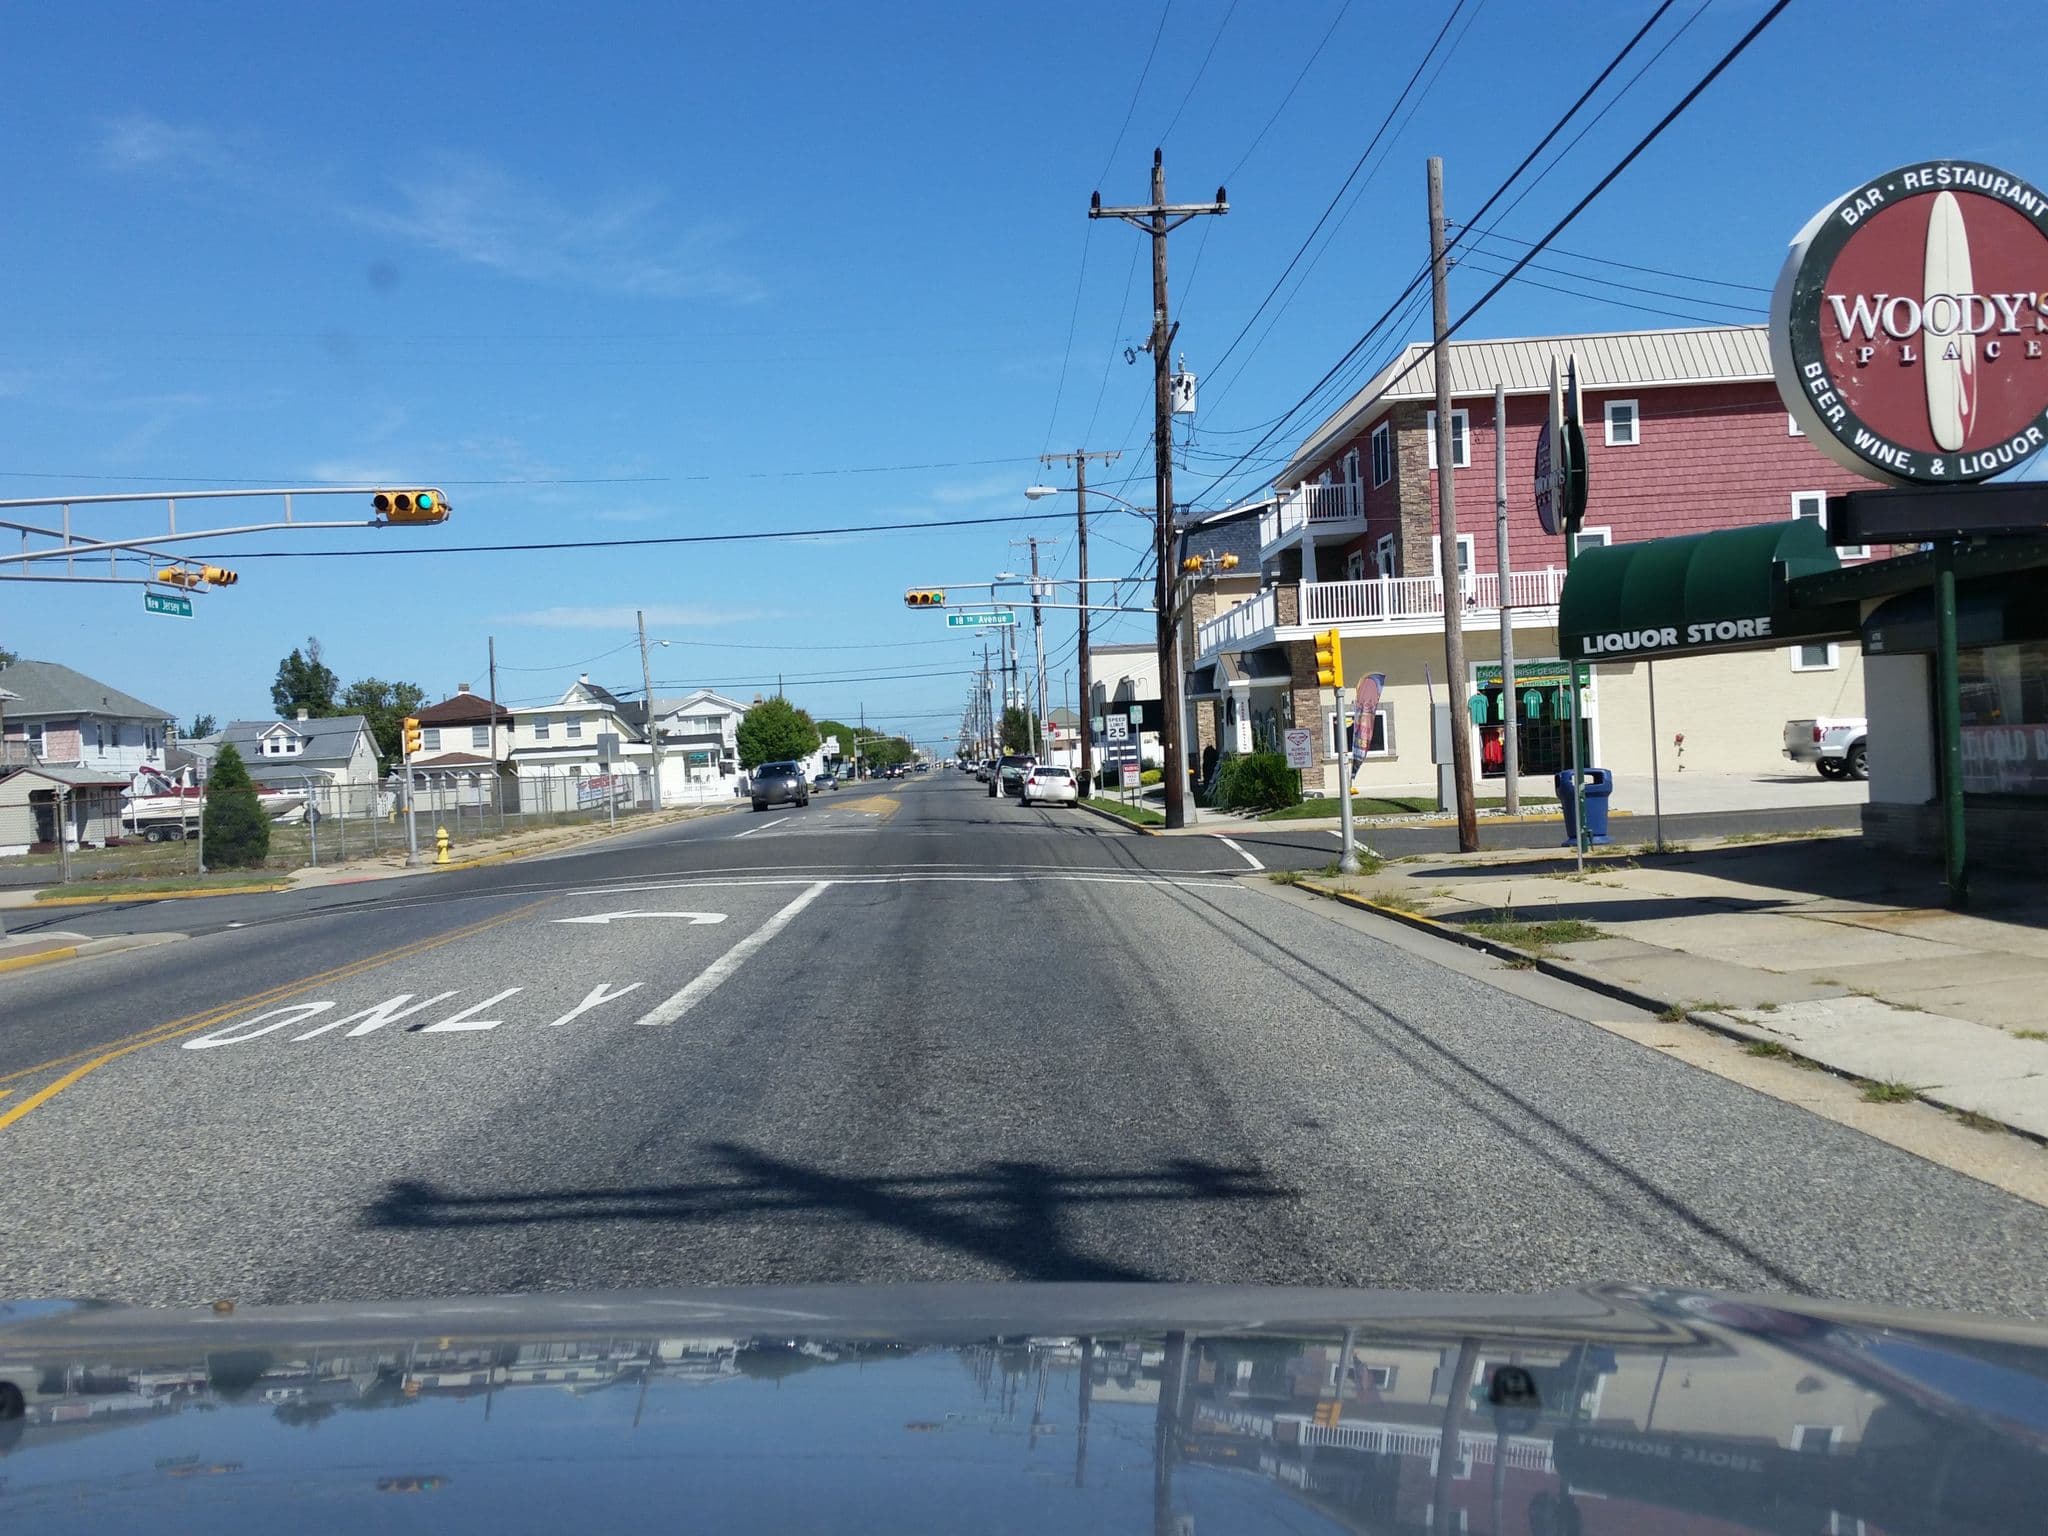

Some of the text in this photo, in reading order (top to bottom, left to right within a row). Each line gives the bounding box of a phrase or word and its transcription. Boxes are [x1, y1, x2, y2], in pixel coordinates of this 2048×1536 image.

[1840, 166, 2048, 227] BAR RESTAURANT
[1859, 341, 2043, 363] PLACE
[1804, 361, 2044, 475] BEER, WINE, & LIQUOR
[162, 599, 180, 614] Jersey
[955, 616, 964, 625] 18
[978, 615, 1007, 624] Avenue
[1583, 617, 1772, 654] LIQUOR STORE
[1109, 727, 1126, 738] 25
[181, 982, 645, 1050] ONLY
